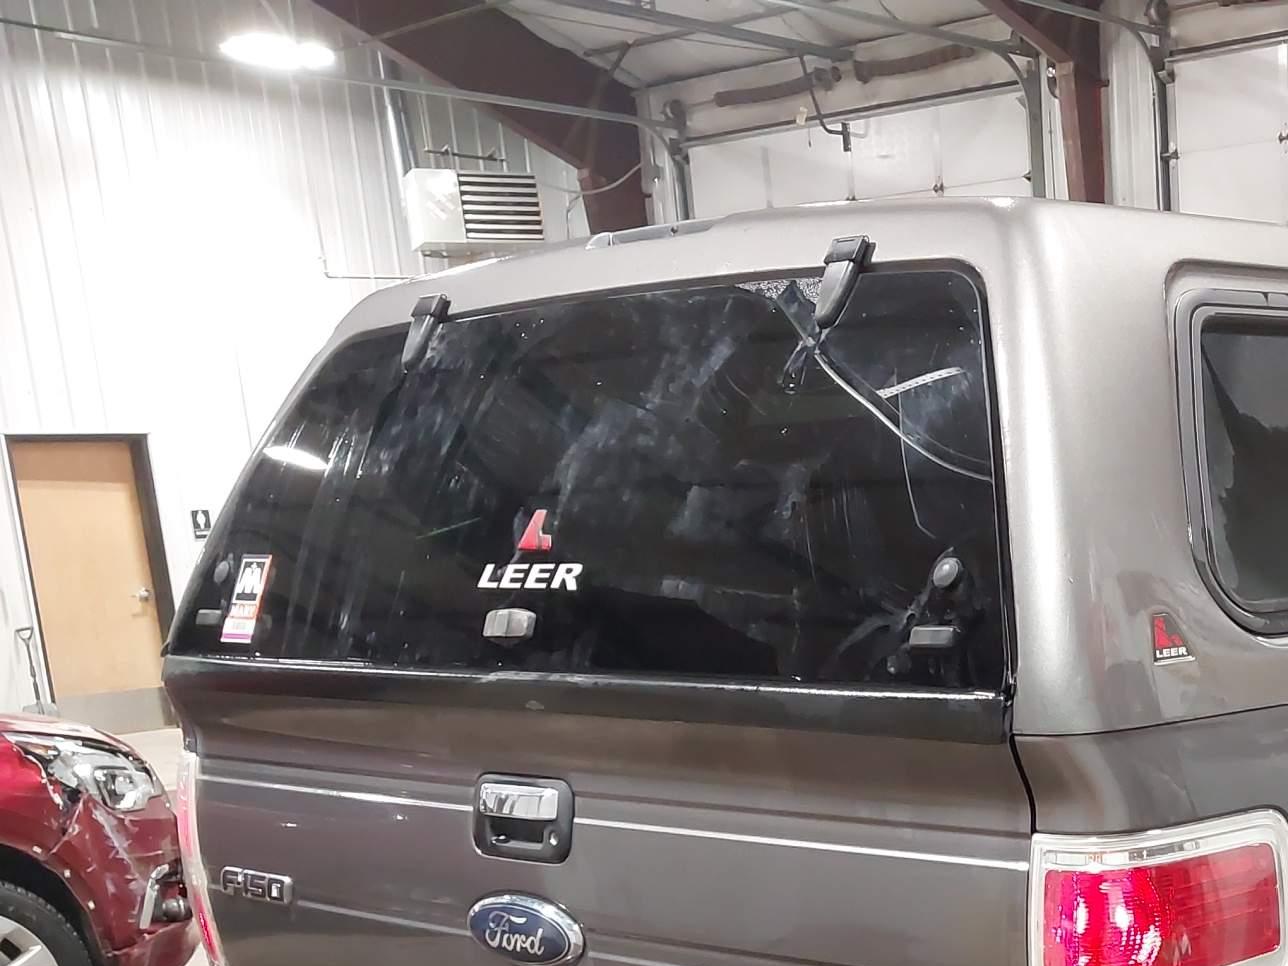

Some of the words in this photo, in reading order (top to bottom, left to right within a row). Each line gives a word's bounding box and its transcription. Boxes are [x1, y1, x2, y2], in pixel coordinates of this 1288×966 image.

[477, 563, 584, 591] LEER
[1155, 646, 1188, 658] LEER
[485, 910, 545, 956] Ford
